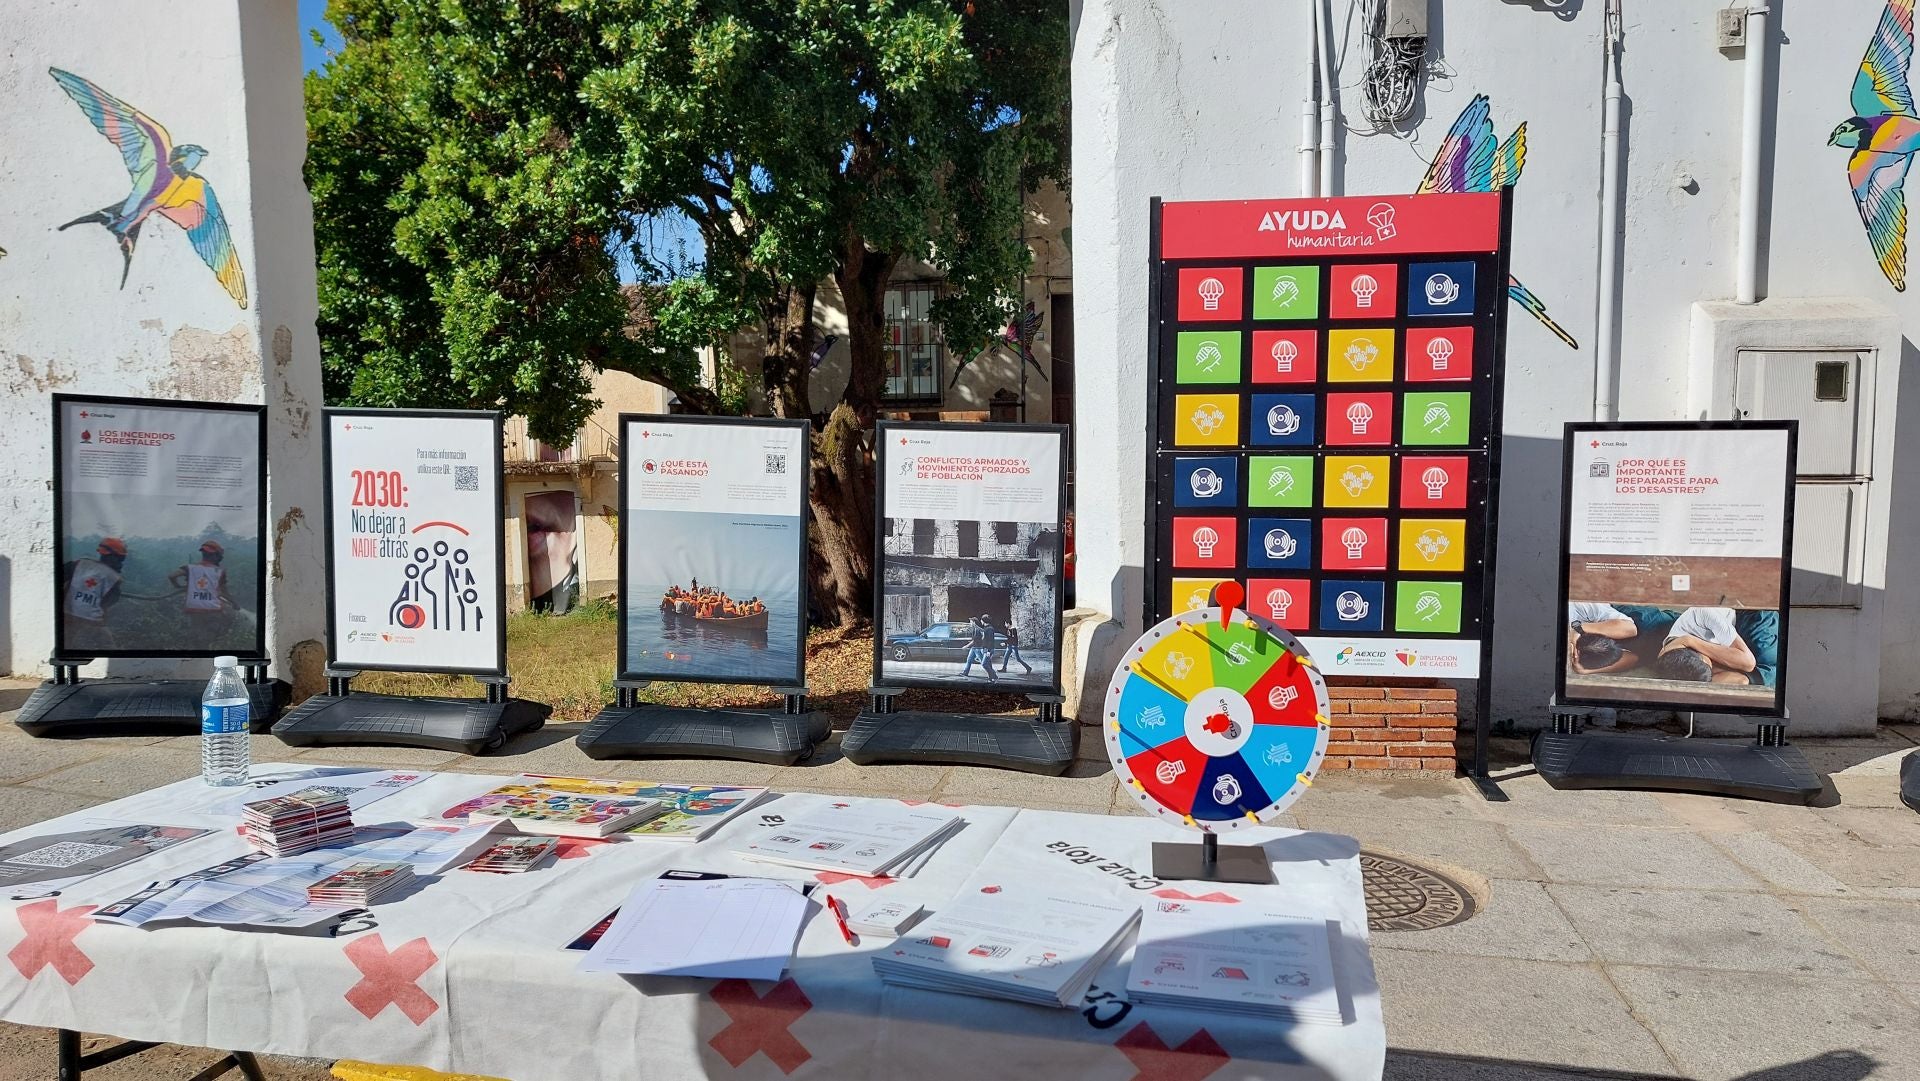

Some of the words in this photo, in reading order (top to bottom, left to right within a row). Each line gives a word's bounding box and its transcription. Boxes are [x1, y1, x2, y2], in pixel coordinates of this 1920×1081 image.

[1258, 209, 1347, 231] AYUDA
[1287, 229, 1374, 249] humanitaria
[99, 430, 118, 438] LOS
[120, 431, 175, 441] INCENDIOS
[99, 437, 162, 446] FORESTALES
[660, 459, 684, 469] ¿QUÉ
[686, 459, 708, 469] ESTÁ
[917, 456, 972, 465] CONFLICTOS
[974, 458, 1019, 466] ARMADOS
[1616, 459, 1645, 468] ¿POR
[1647, 457, 1670, 468] QUÉ
[1673, 459, 1686, 467] ES
[660, 468, 709, 477] PASANDO?
[917, 465, 980, 473] MOVIMIENTOS
[981, 466, 1031, 474] FORZADOS
[1616, 468, 1686, 476] IMPORTANTE
[931, 472, 983, 481] POBLACIÓN
[1616, 477, 1686, 485] PREPARARSE
[1689, 477, 1719, 485] PARA
[351, 470, 409, 508] 2030:
[1615, 486, 1636, 494] LOS
[1638, 486, 1706, 494] DESASTRES?
[352, 509, 366, 533] No
[369, 509, 397, 539] dejar
[399, 516, 406, 535] a
[352, 538, 378, 558] NADIE
[379, 534, 409, 559] atrás
[74, 591, 98, 608] PMI
[193, 591, 212, 601] PMI
[1354, 650, 1387, 658] AEXCID
[1229, 719, 1238, 738] Cru
[1045, 841, 1108, 865] Roja
[1096, 862, 1164, 890] Cruz
